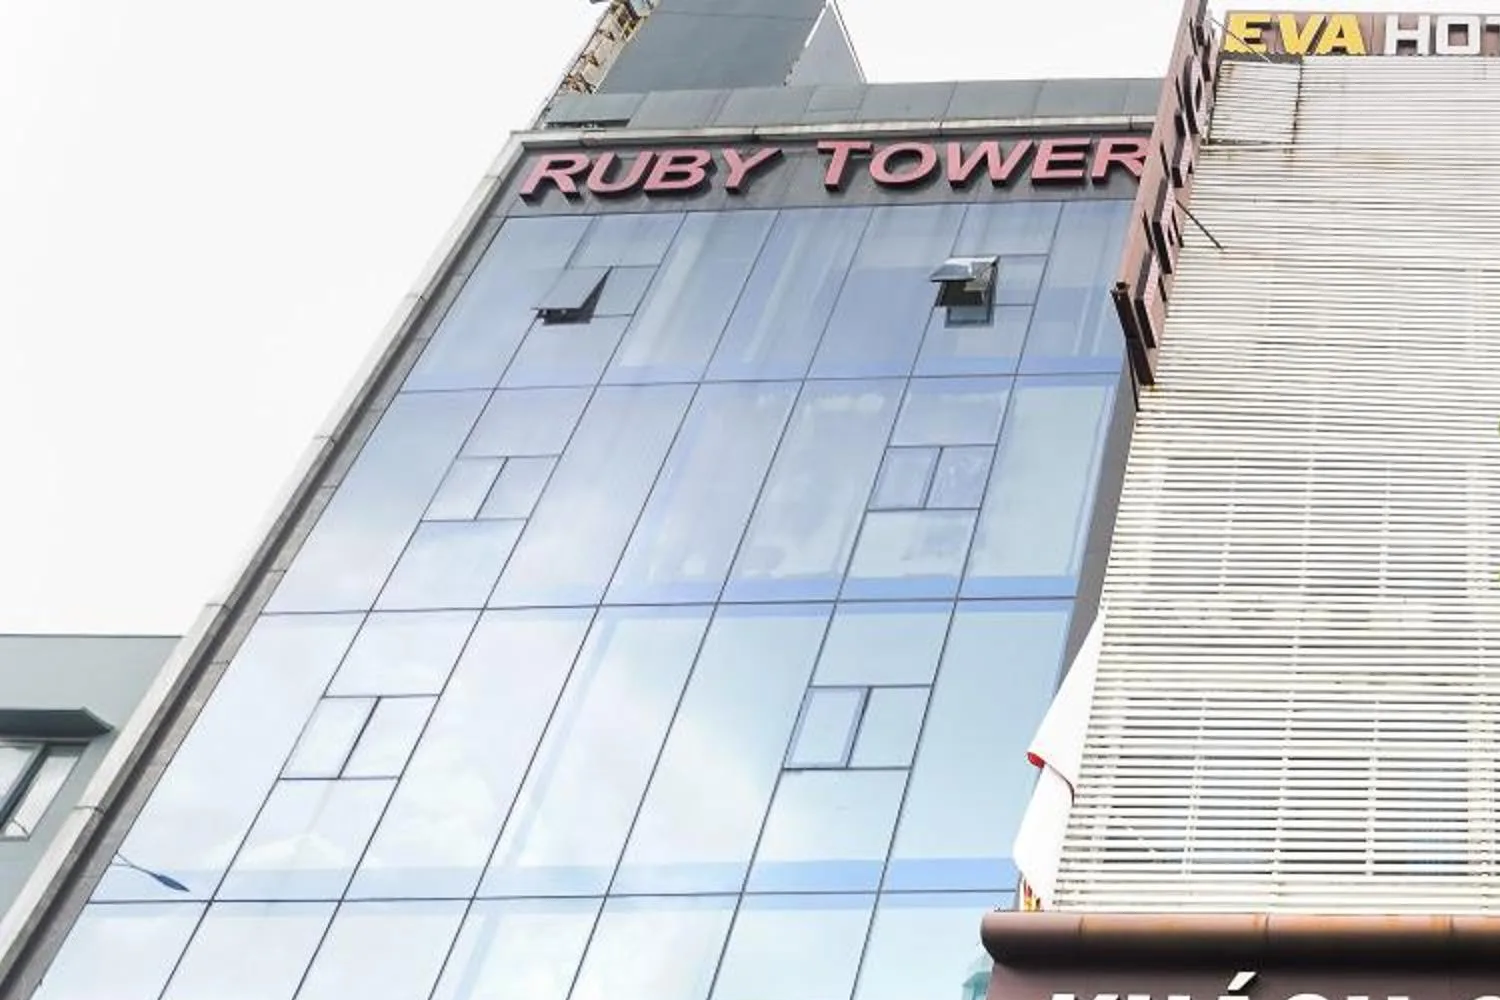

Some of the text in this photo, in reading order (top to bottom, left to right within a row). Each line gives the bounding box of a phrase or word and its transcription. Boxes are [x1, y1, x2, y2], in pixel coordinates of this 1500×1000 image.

[1225, 13, 1367, 55] EVA
[519, 136, 1152, 199] RUBY TOWER
